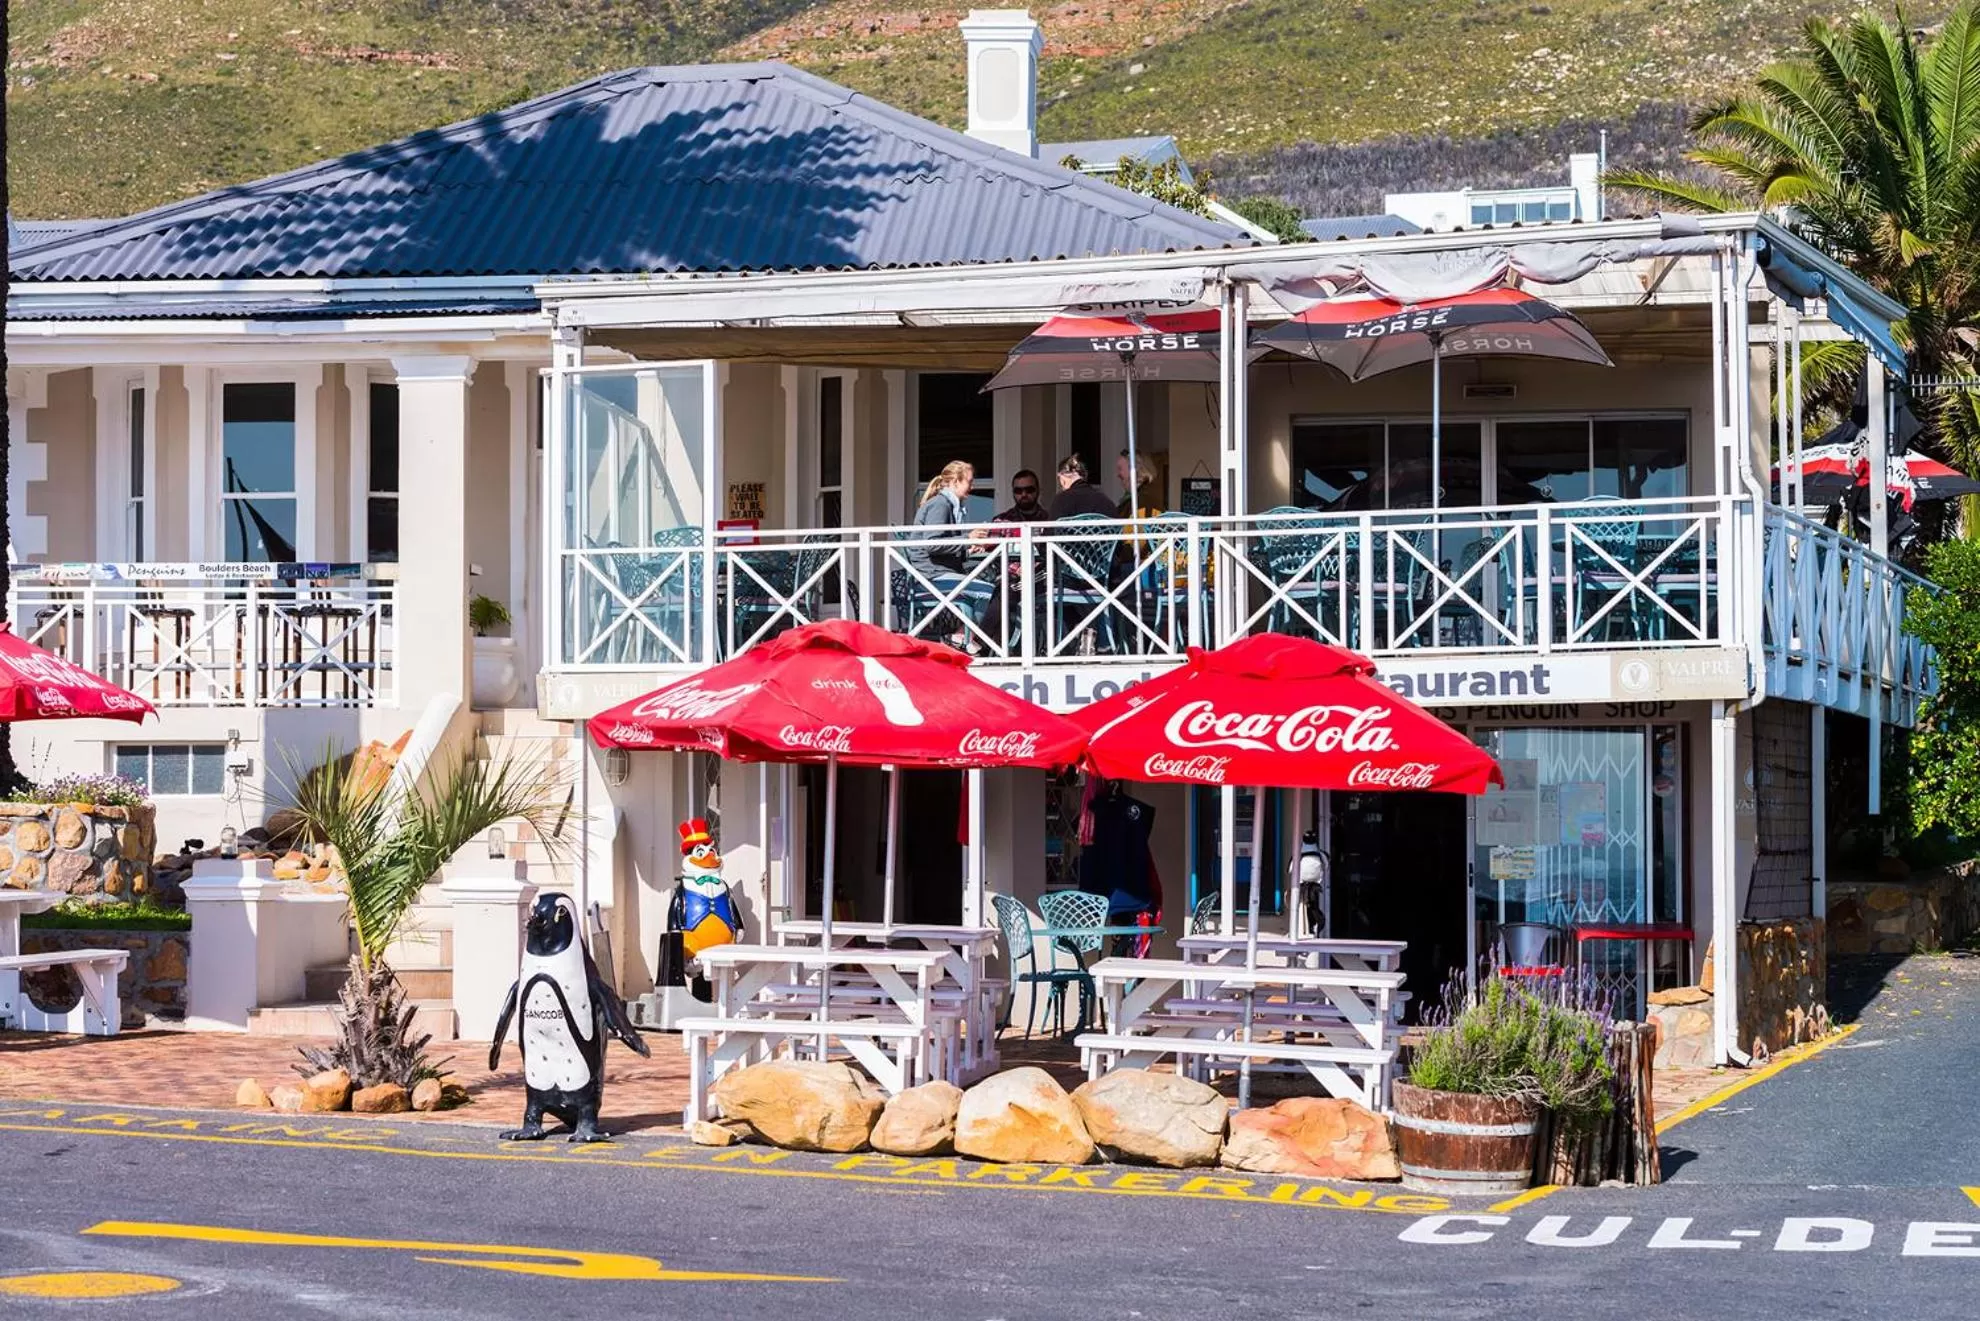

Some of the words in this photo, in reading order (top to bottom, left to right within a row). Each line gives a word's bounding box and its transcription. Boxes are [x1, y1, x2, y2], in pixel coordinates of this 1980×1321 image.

[1344, 311, 1448, 338] HORSE
[1092, 336, 1201, 351] HORSE
[730, 483, 765, 492] PLEASE
[730, 510, 764, 519] SEATED
[733, 502, 746, 510] TO
[749, 502, 761, 510] BE
[199, 564, 241, 572] Boulders
[242, 564, 271, 572] Beach
[811, 678, 859, 690] drink
[1604, 701, 1676, 718] SHOP
[1164, 700, 1400, 753] Coca-Cola
[779, 724, 854, 753] Coca-Cola
[959, 728, 1041, 758] Coca-Cola
[1144, 752, 1232, 783] Coca-Cola
[1348, 760, 1440, 789] Coca-Cola
[832, 1154, 1451, 1212] PARKERING
